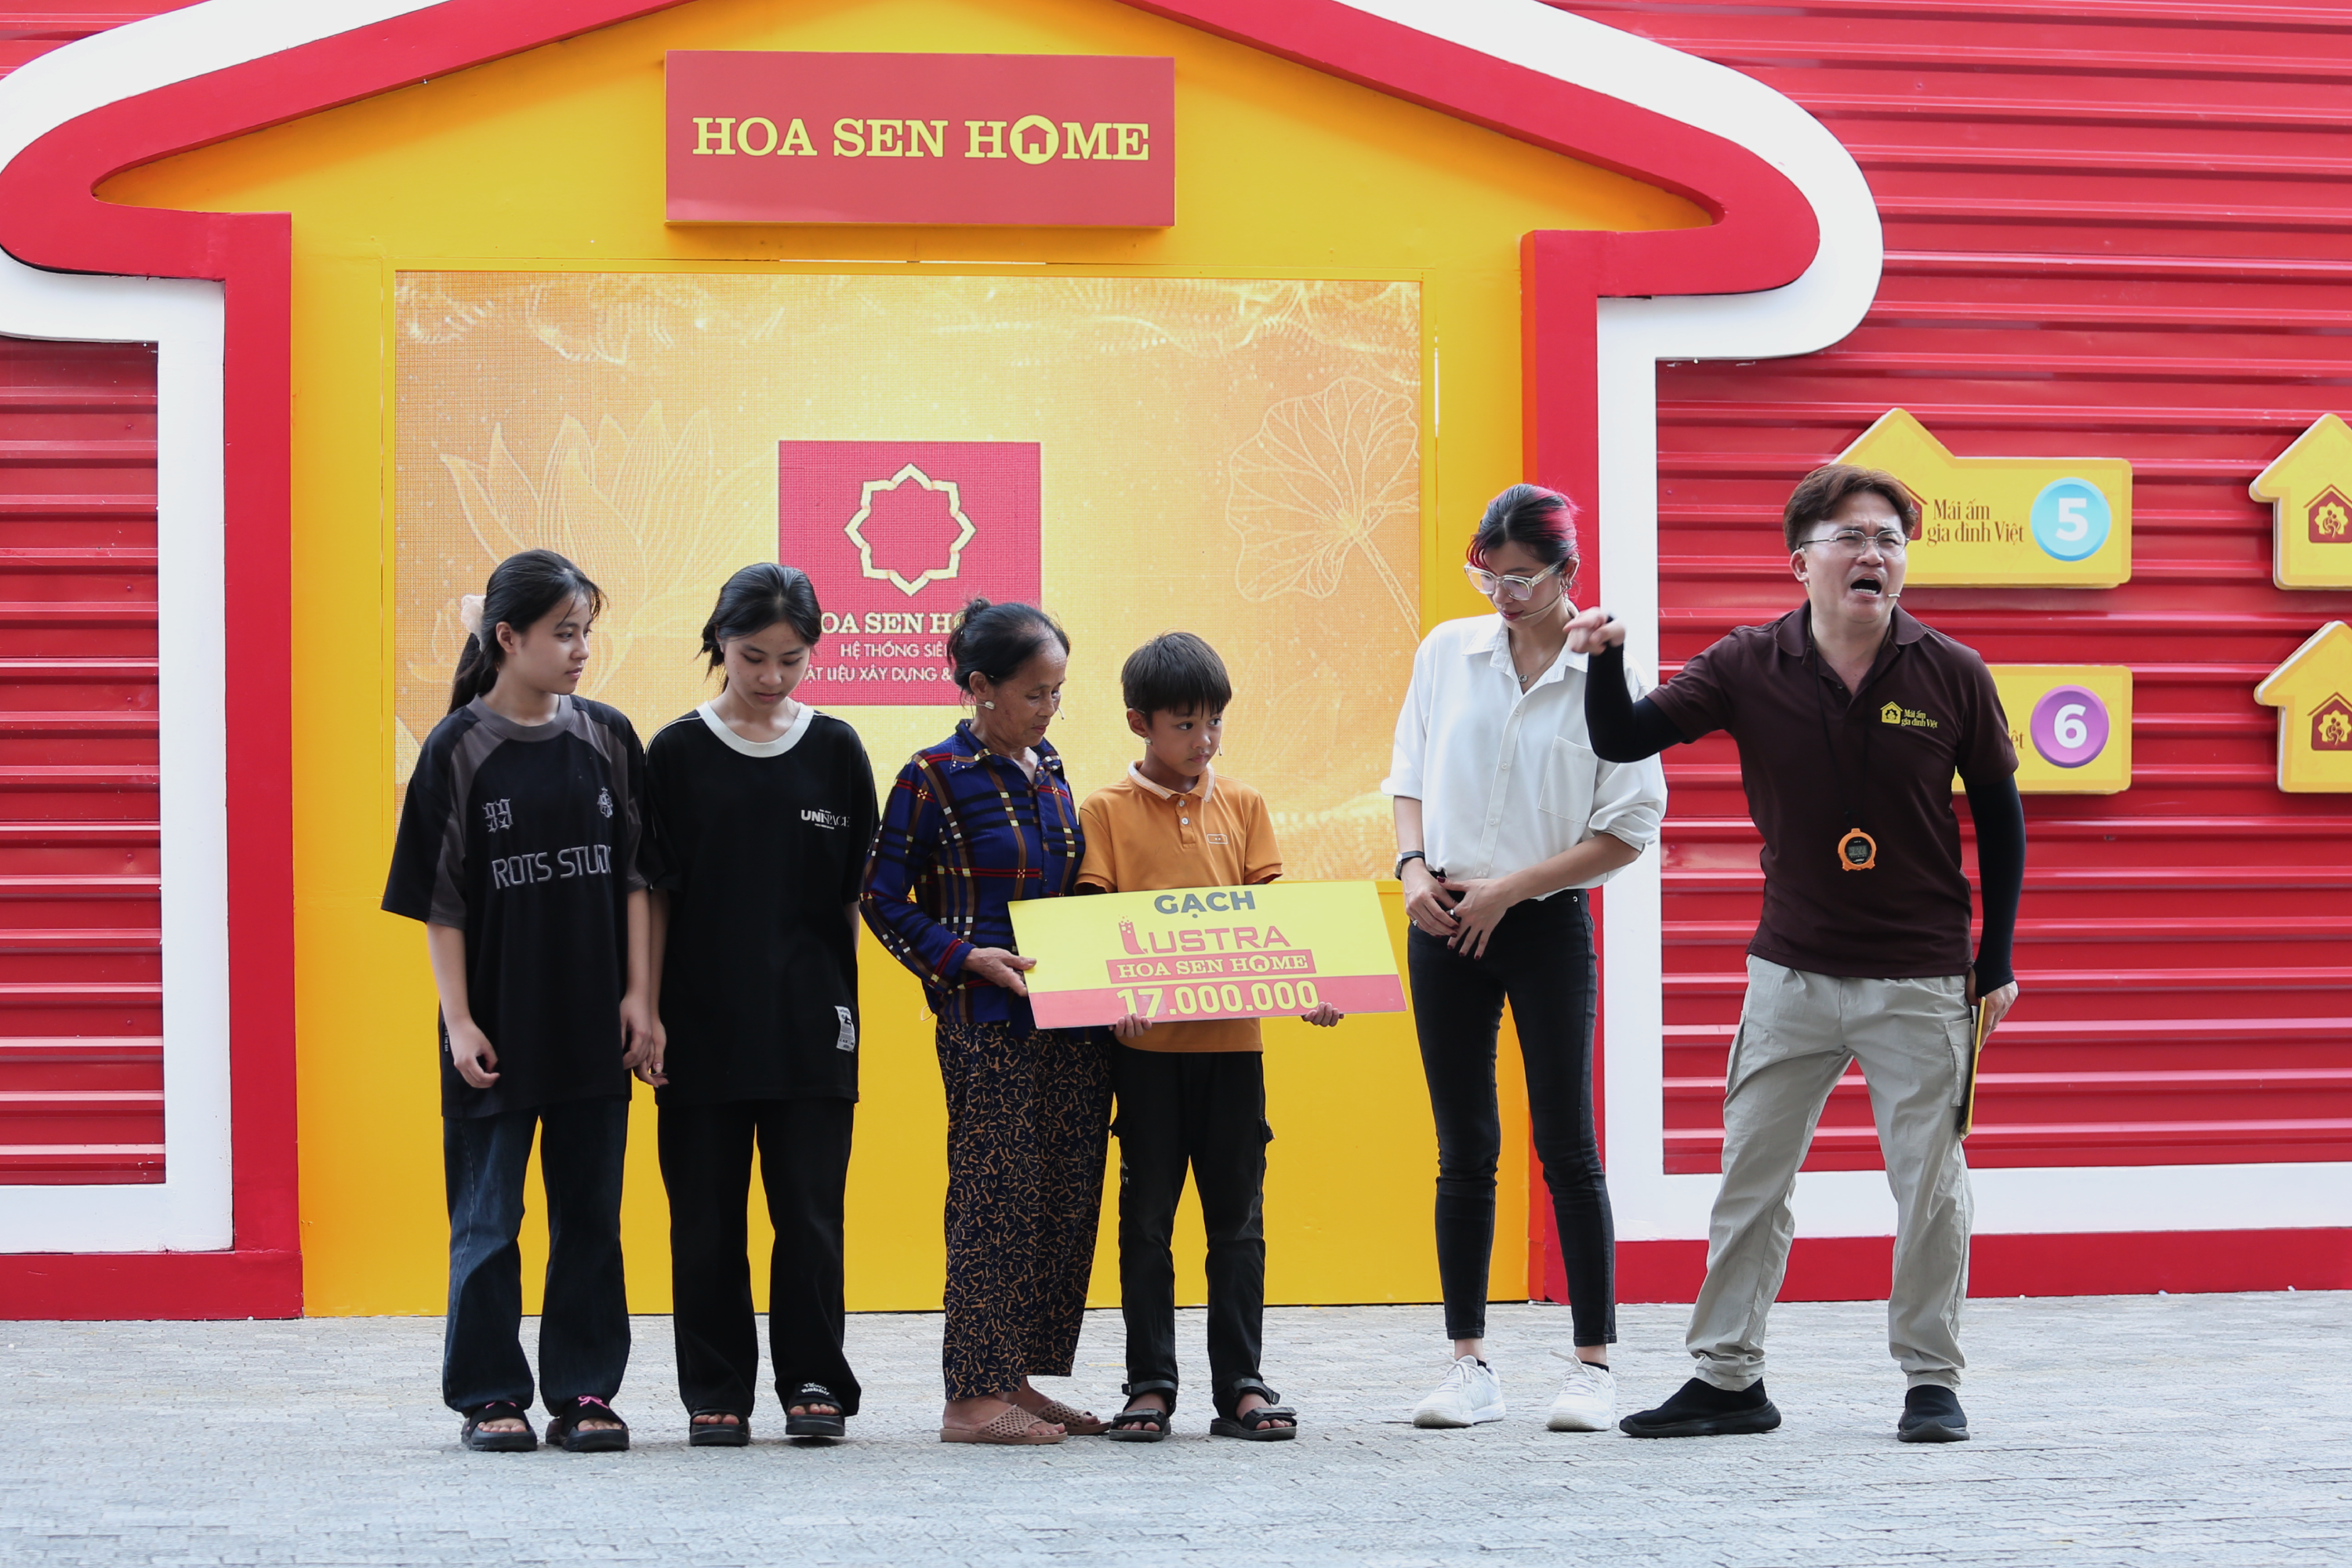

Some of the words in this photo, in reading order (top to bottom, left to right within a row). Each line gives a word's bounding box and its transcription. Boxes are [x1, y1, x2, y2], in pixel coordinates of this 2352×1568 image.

[693, 116, 818, 157] HOA
[833, 118, 949, 158] SEN
[964, 114, 1150, 165] HOME
[1933, 499, 1961, 520] Mái
[1965, 498, 1990, 521] ấm
[2055, 497, 2089, 541] 5
[1926, 523, 1950, 548] gia
[1955, 521, 1991, 543] đình
[1994, 521, 2024, 546] Việt
[821, 612, 860, 634] OA
[865, 612, 924, 634] SEN
[840, 640, 861, 660] HỆ
[864, 639, 920, 659] THỐNG
[924, 640, 947, 658] SIÊ
[804, 663, 823, 684] ẬT
[826, 663, 855, 684] LIỆU
[859, 663, 887, 681] XÂY
[2053, 703, 2088, 750] 6
[492, 851, 553, 889] ROTS
[1154, 890, 1256, 919] GẠCH
[1118, 920, 1292, 956] LUSTRA
[1116, 962, 1172, 978] HOA
[1176, 958, 1224, 975] SEN
[1229, 954, 1308, 973] HOME
[1116, 980, 1319, 1018] 17.000.000
